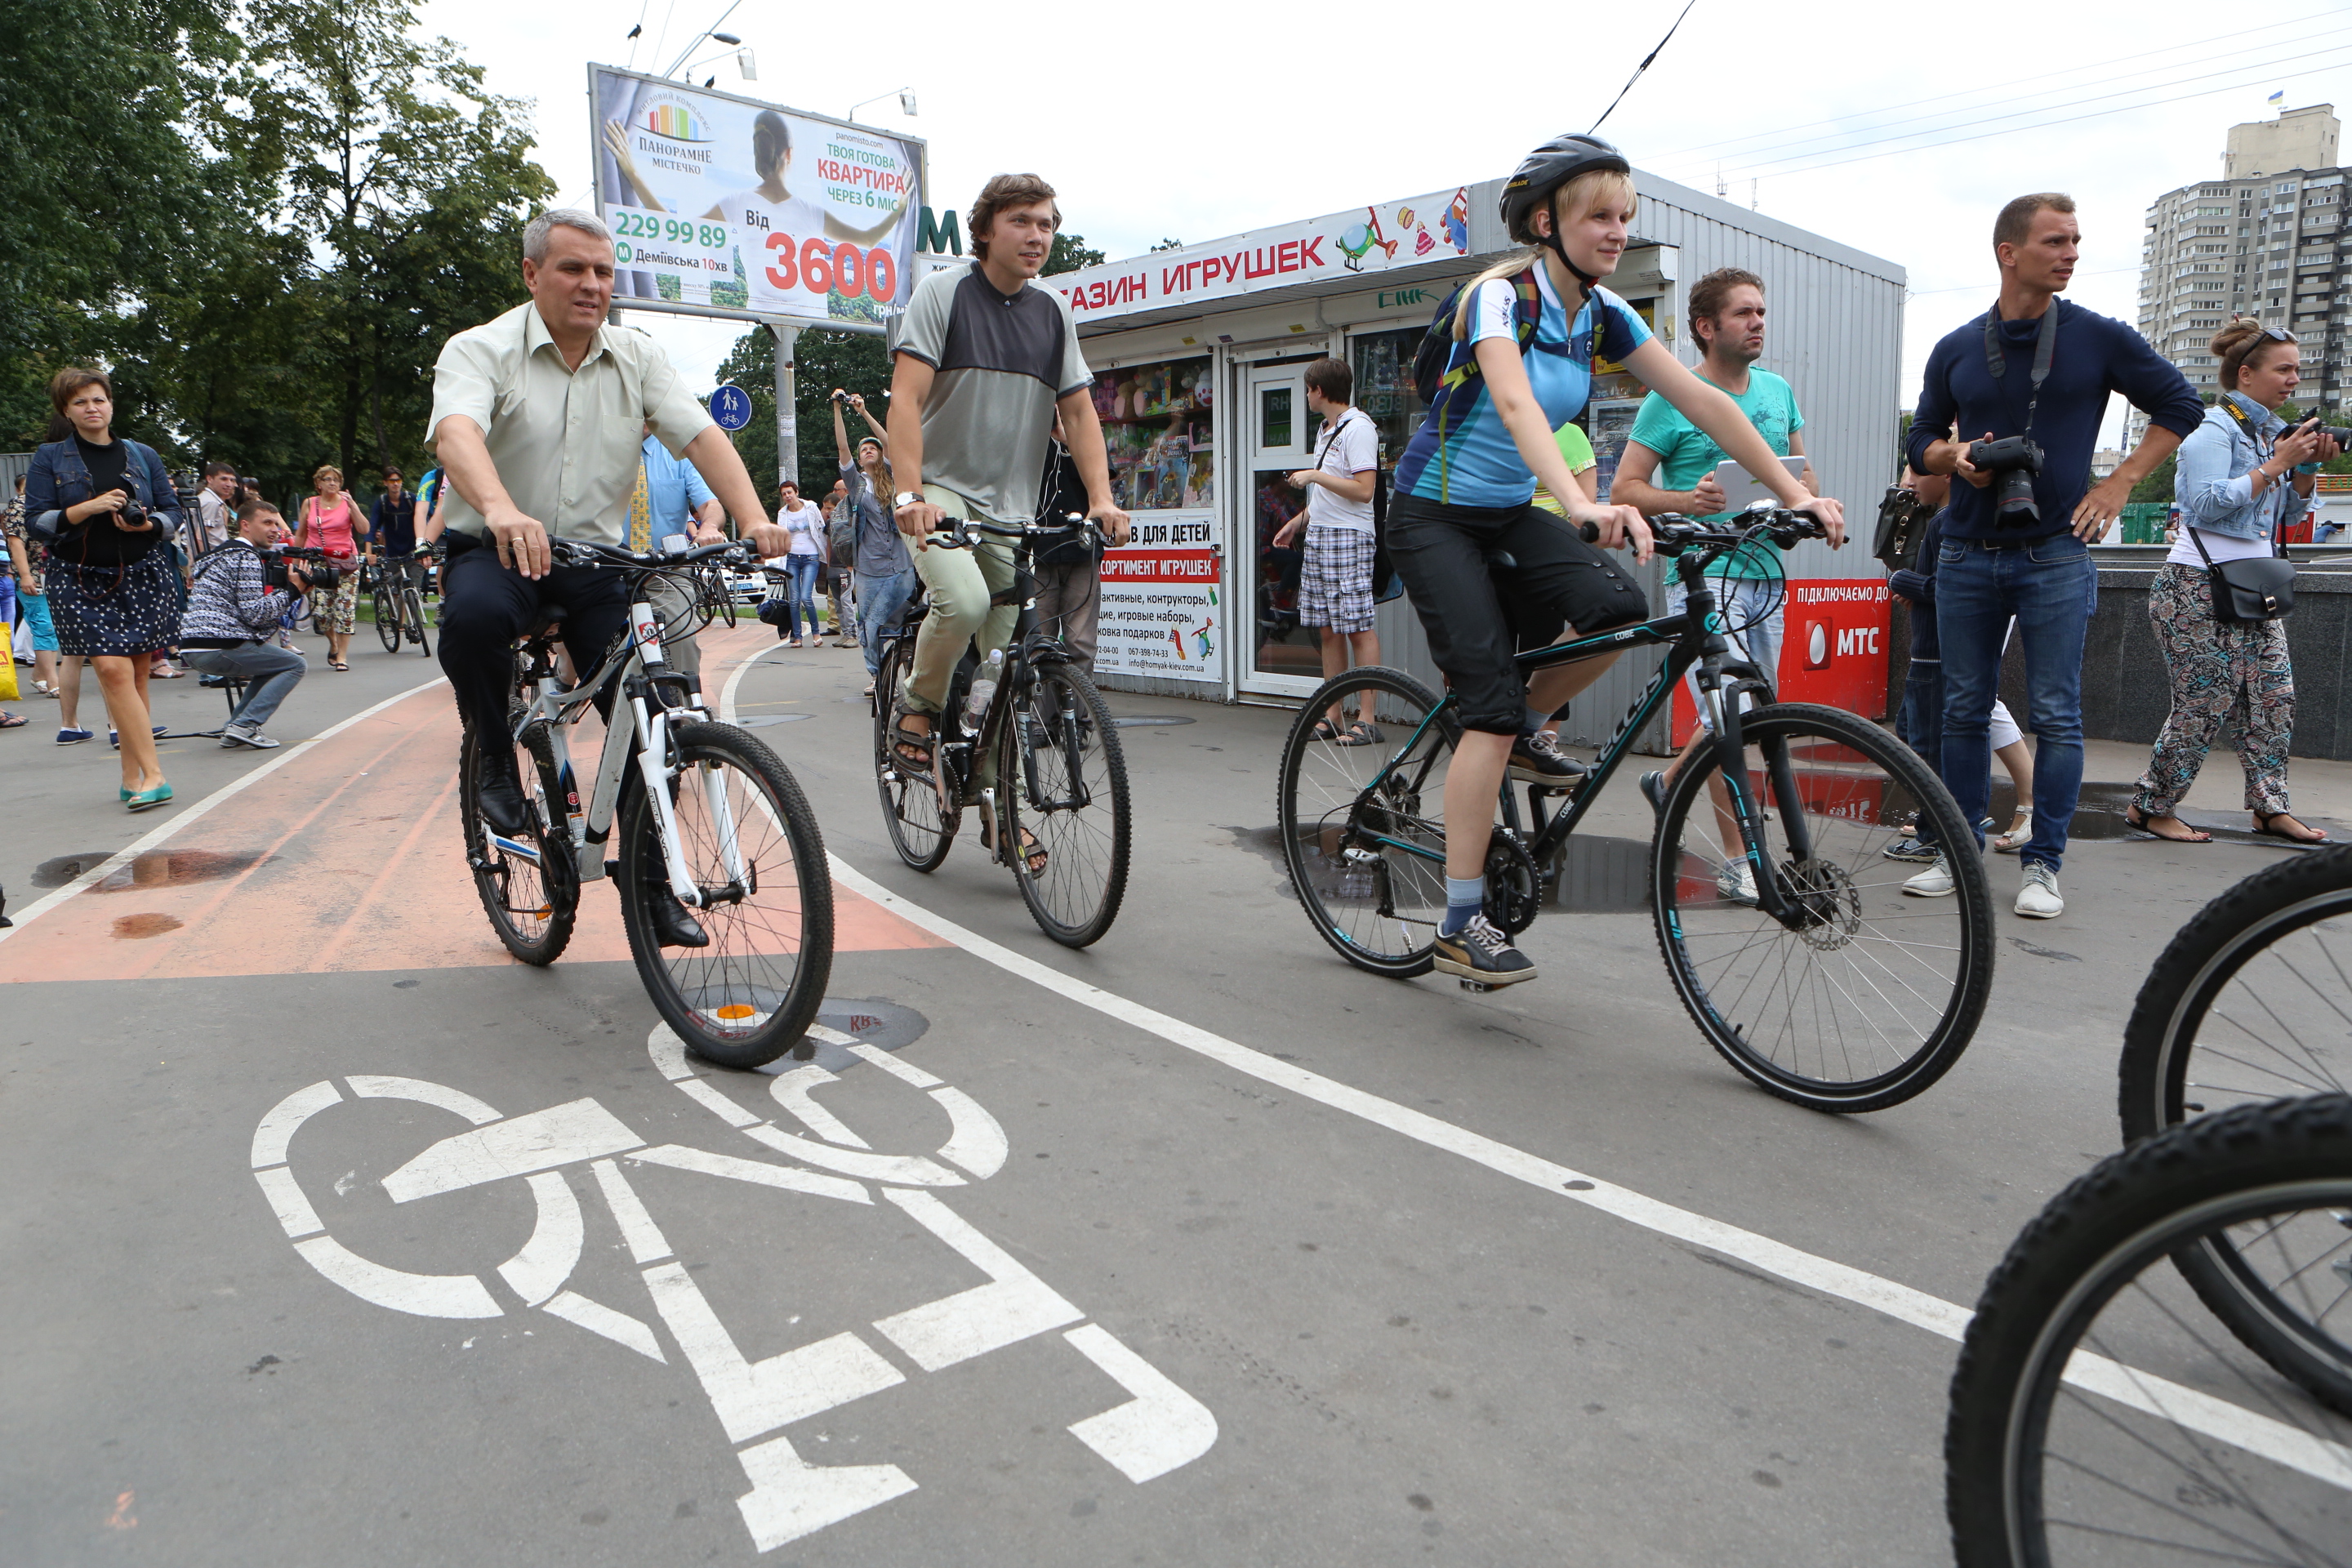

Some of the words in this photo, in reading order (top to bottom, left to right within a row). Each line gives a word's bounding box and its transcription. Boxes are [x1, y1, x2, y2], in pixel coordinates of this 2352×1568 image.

[639, 136, 712, 163] ПАНОРАМНЕ
[836, 132, 884, 149] panomisto.com
[653, 158, 701, 175] МІСТЕЧКО
[826, 143, 854, 161] ТВОЯ
[857, 150, 896, 170] ГОТОВА
[817, 158, 906, 195] КВАРТИРА
[828, 186, 862, 205] ЧЕРЕЗ
[866, 190, 875, 207] 6
[615, 212, 660, 239] 229
[665, 219, 693, 244] 99
[699, 225, 726, 248] 89
[746, 210, 769, 231] Від
[765, 232, 896, 302] 3600
[1059, 272, 1147, 313] АЗИН
[1163, 235, 1325, 295] ИГРУШЕК
[2228, 403, 2245, 420] Nikon
[1143, 524, 1168, 546] ДЛЯ
[1171, 520, 1210, 545] ДЕТЕЙ
[1099, 560, 1156, 575] СОРТИМЕНТ
[1160, 560, 1212, 576] ИГРУШЕК
[1147, 595, 1209, 608] контрукторы,
[1797, 586, 1873, 605] ПІДКЛЮЧАЄМО
[1875, 586, 1889, 604] ДО
[1118, 612, 1154, 622] игровые
[1156, 612, 1195, 625] наборы,
[1123, 629, 1165, 641] подарков
[1837, 627, 1880, 657] МТС
[1128, 648, 1169, 658] 067-398-74-33
[1129, 659, 1205, 672] info@homyak-kiev.com.ua
